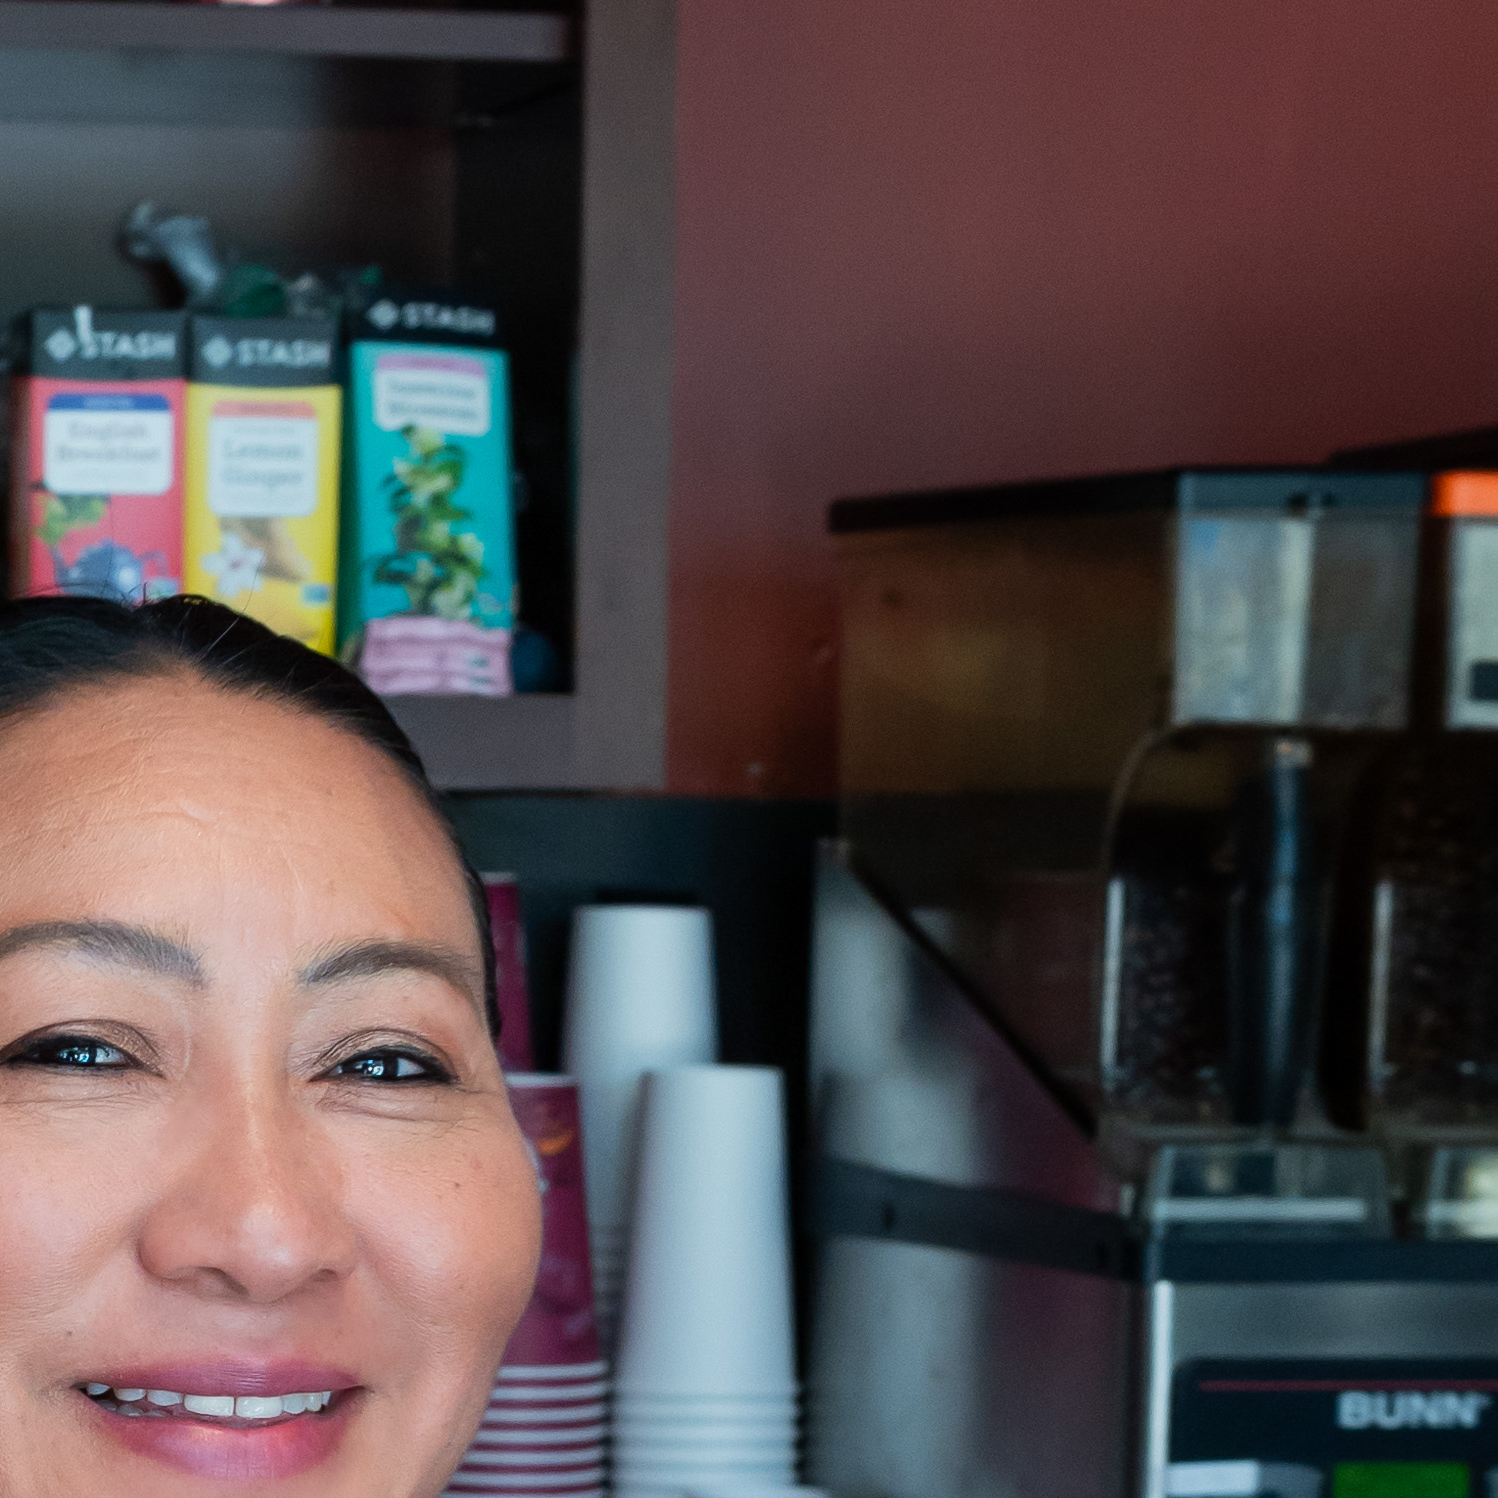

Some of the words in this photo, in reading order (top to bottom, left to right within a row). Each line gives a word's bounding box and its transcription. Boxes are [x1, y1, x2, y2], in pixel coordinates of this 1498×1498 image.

[401, 301, 495, 336] STASH
[79, 329, 177, 359] STASH
[237, 338, 331, 368] STASH
[1336, 1391, 1482, 1429] BUNN
